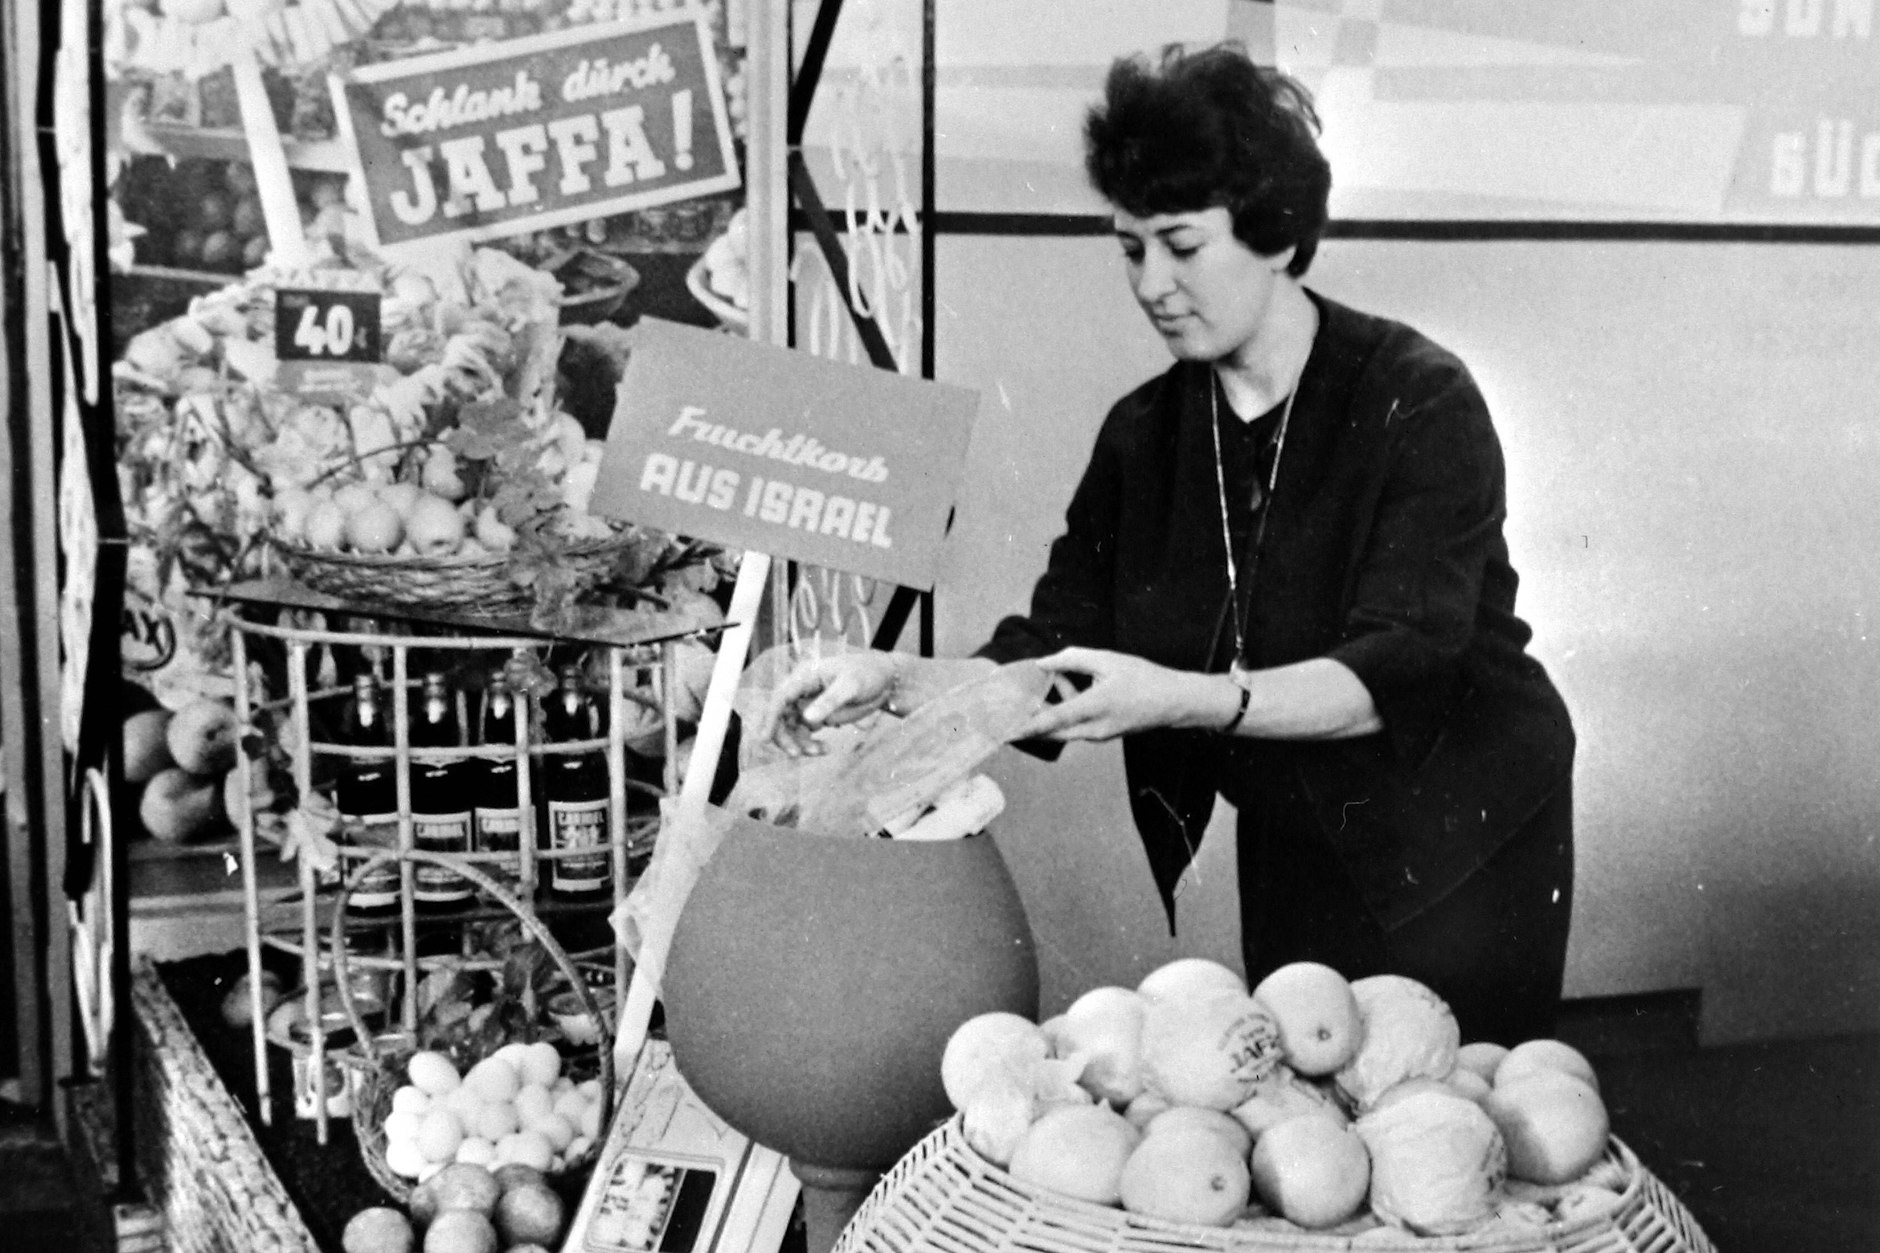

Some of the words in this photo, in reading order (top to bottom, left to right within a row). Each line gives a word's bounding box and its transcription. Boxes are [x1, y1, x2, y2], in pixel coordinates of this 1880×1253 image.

[380, 70, 542, 137] Schlank
[390, 89, 694, 225] JAFFA!
[294, 304, 354, 355] 40
[640, 452, 741, 511] AUS
[743, 476, 893, 548] ISRAEL
